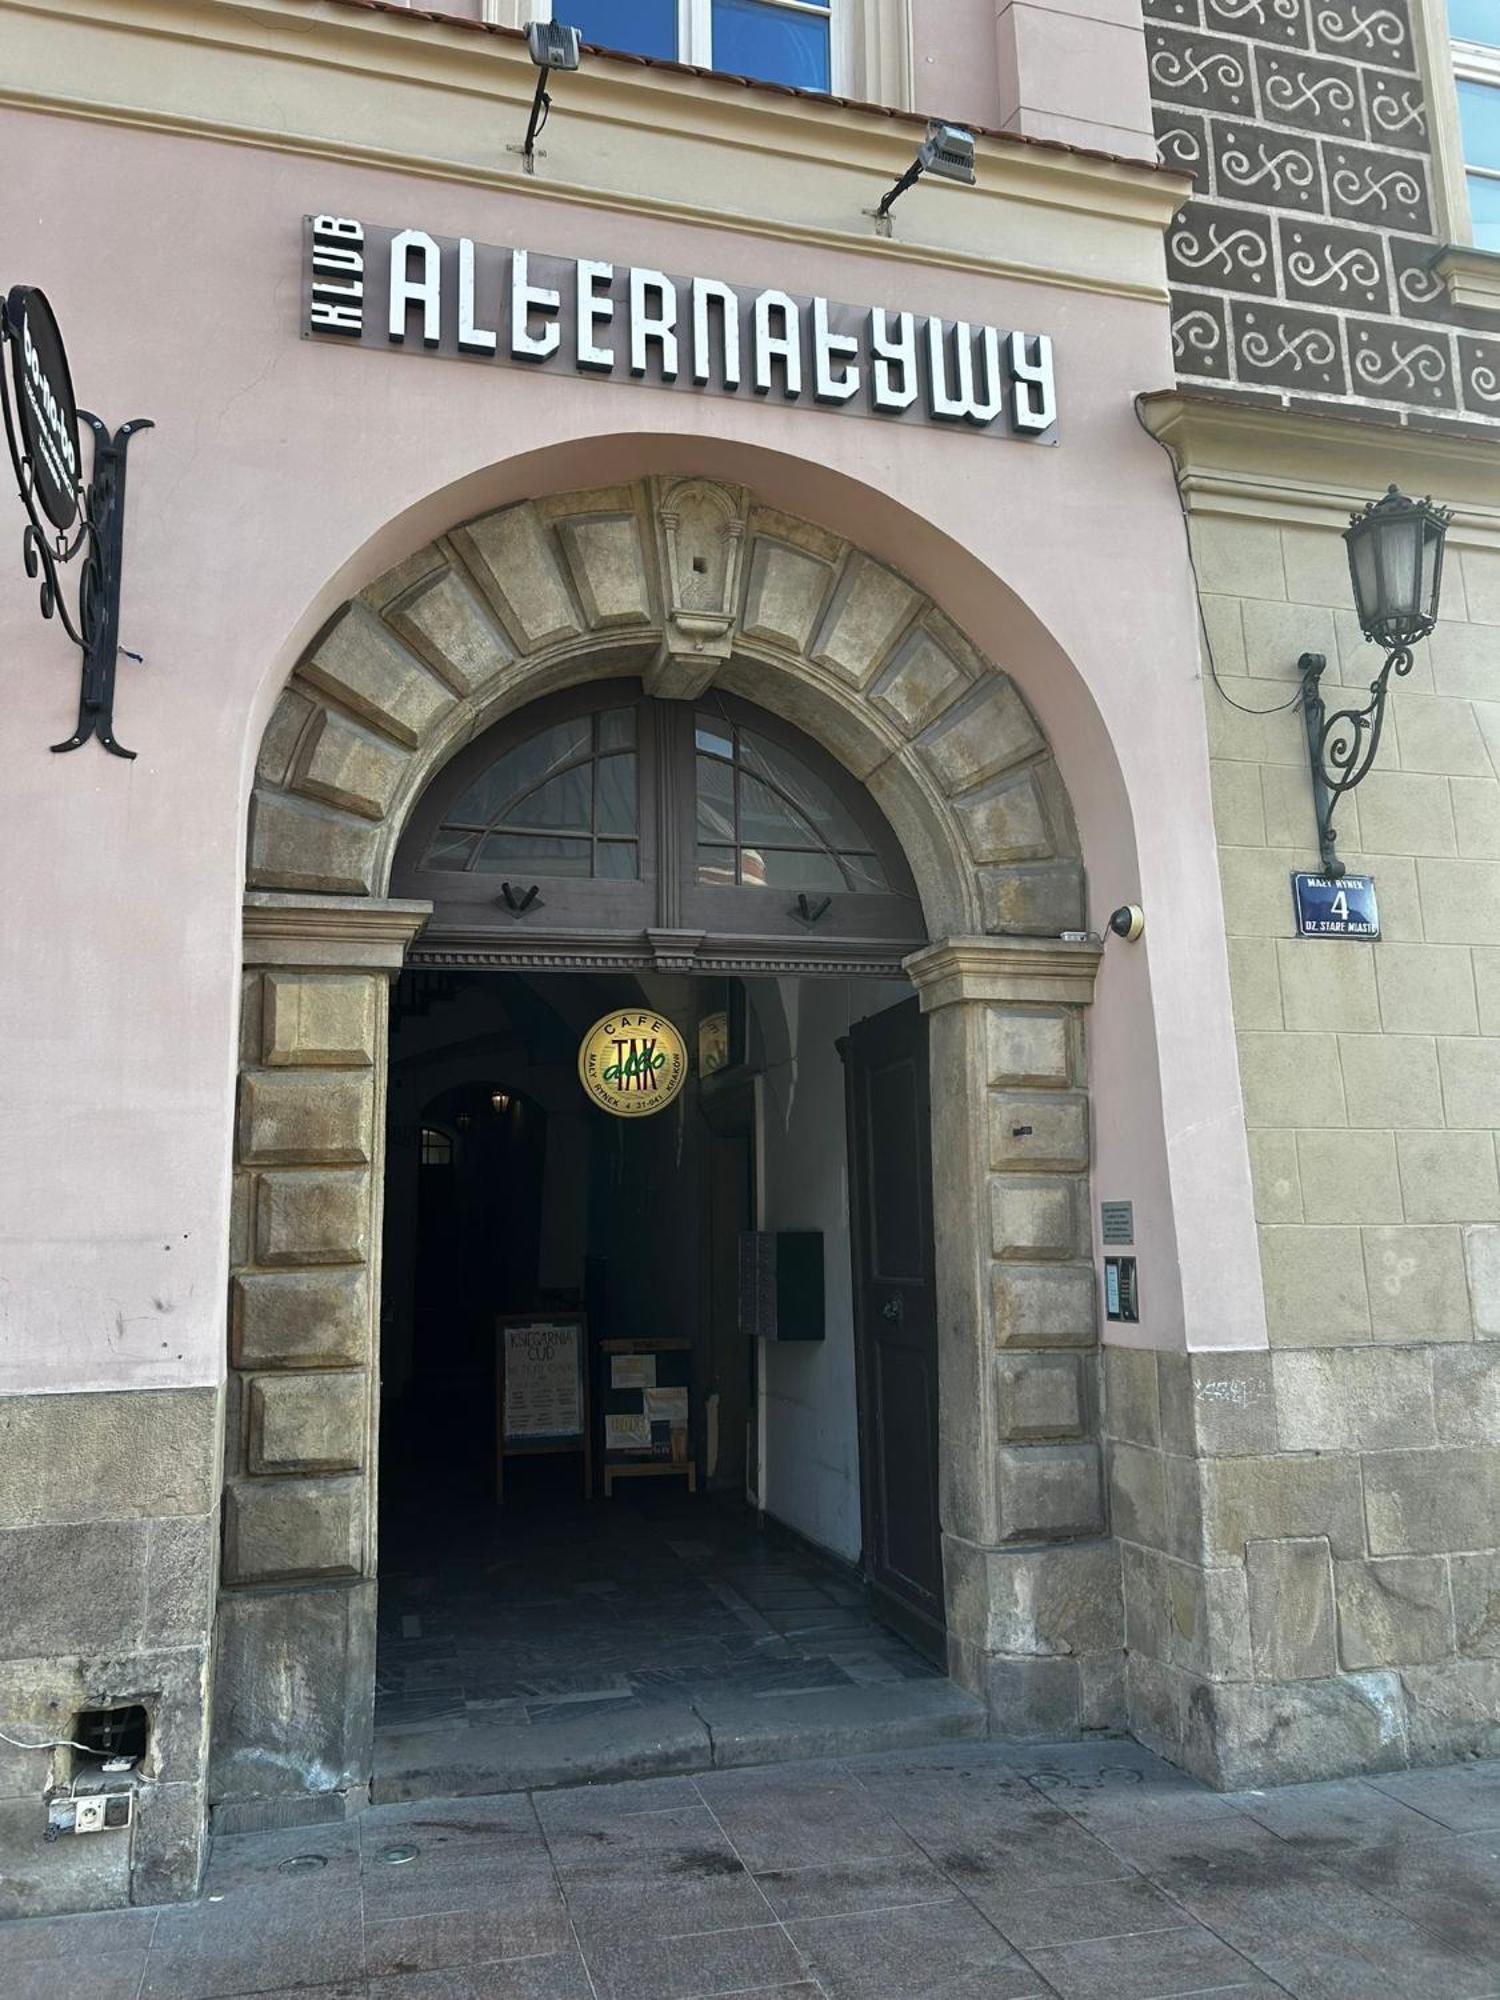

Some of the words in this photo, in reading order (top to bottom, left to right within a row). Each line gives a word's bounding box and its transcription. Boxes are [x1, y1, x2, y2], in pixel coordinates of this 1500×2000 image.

[312, 213, 364, 335] KLUB
[23, 312, 75, 474] bo-no-bo
[1336, 880, 1364, 889] RYNEK
[1330, 890, 1349, 920] 4
[1320, 921, 1346, 932] STARE
[604, 1016, 662, 1035] CAFE
[611, 1038, 657, 1091] TAK
[595, 1083, 619, 1107] RYNEK
